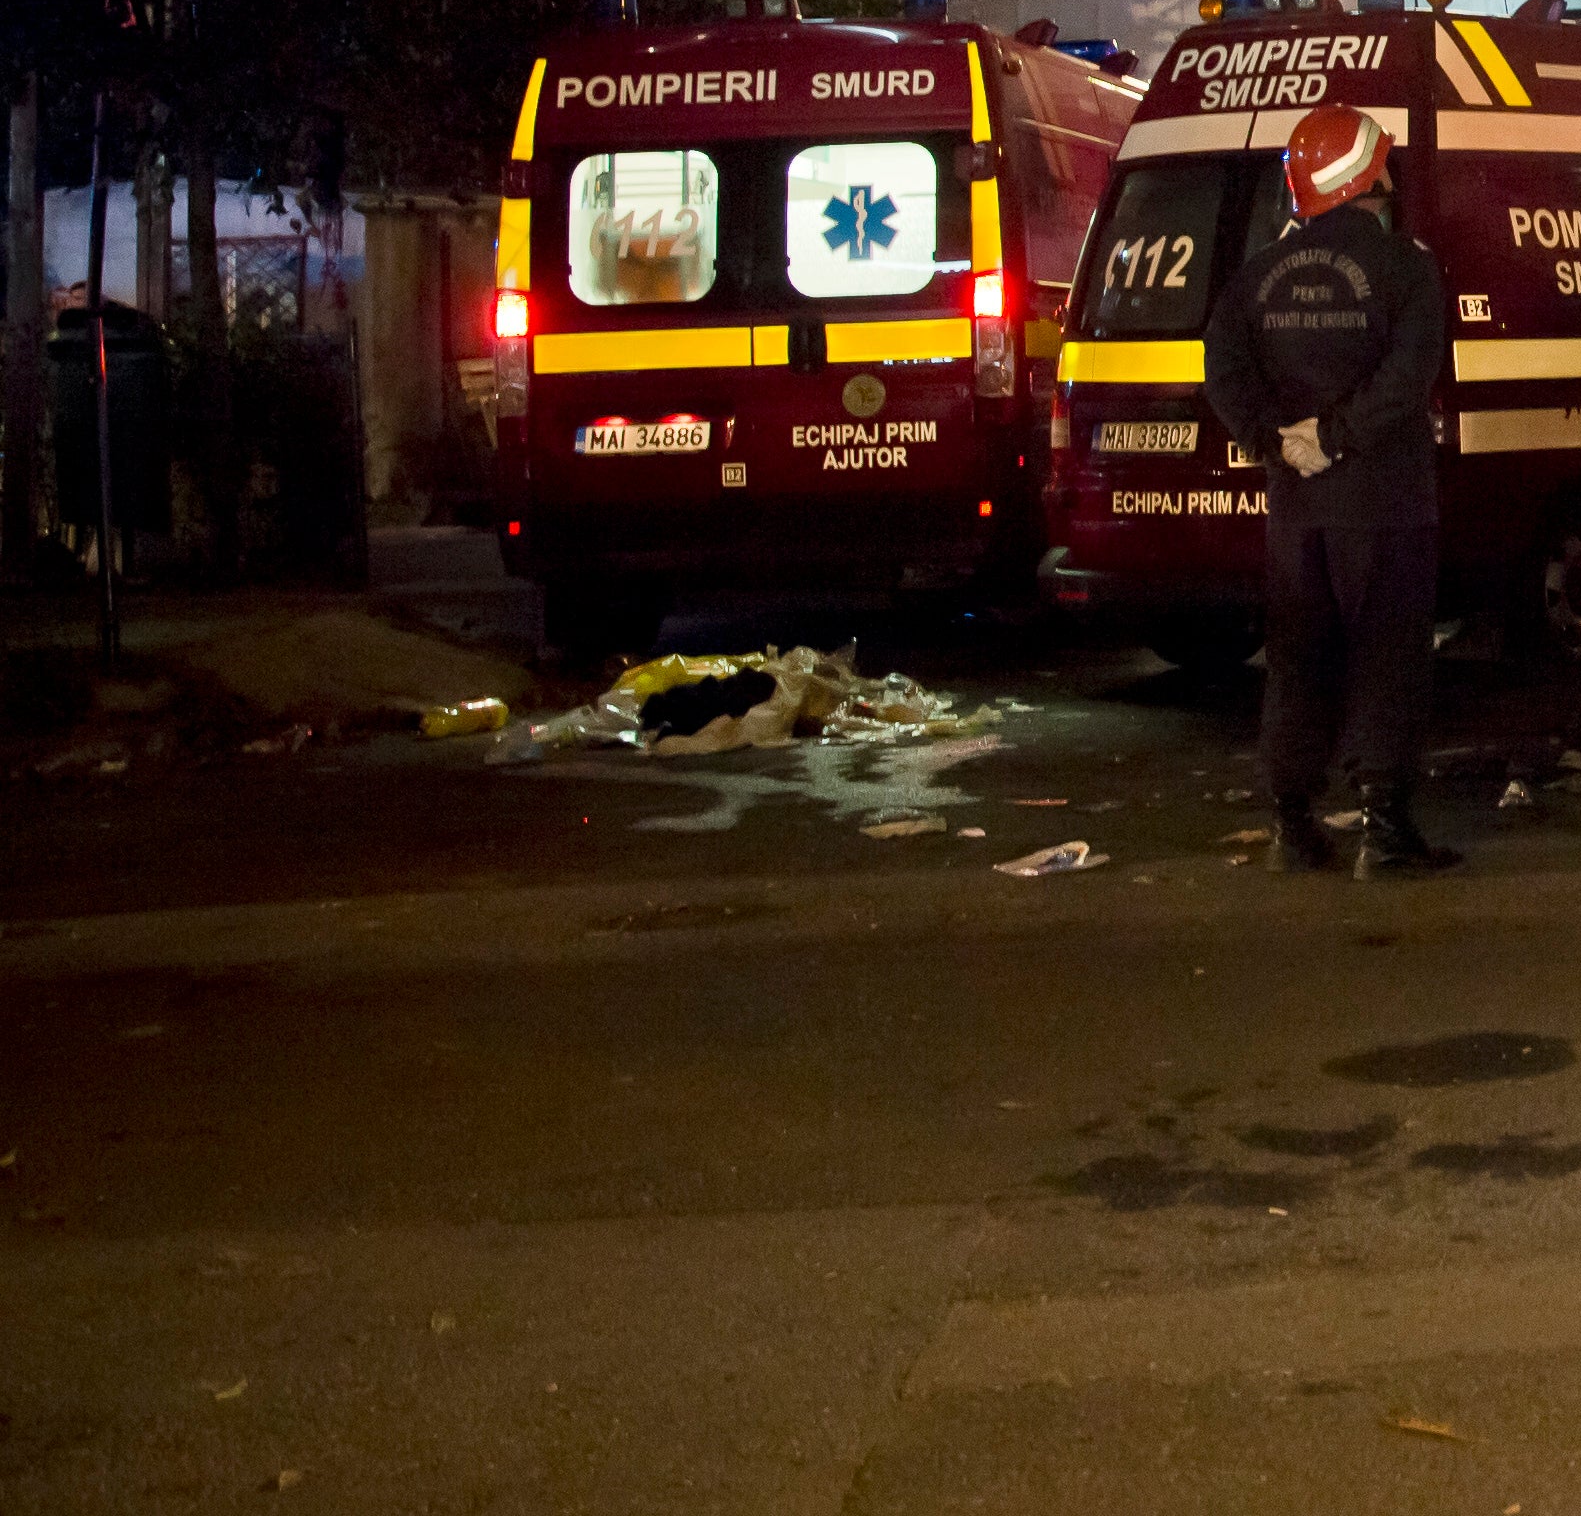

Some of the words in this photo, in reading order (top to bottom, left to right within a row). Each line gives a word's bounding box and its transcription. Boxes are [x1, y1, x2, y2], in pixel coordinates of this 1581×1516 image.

[1171, 35, 1388, 83] POMPIERII
[556, 69, 778, 109] POMPIERII
[811, 68, 936, 99] SMURD
[1200, 73, 1328, 111] SMURD
[1125, 235, 1195, 288] 112
[1466, 299, 1484, 317] B2
[589, 427, 626, 451] MAI
[636, 424, 704, 448] 34886
[792, 424, 880, 448] ECHIPAJ
[886, 421, 937, 444] PRIM
[1104, 424, 1133, 450] MAI
[1136, 423, 1192, 450] 33802
[823, 446, 908, 470] AJUTOR
[1112, 490, 1182, 515] ECHIPAJ
[1187, 490, 1232, 515] PRIM
[1236, 491, 1270, 515] AJU
